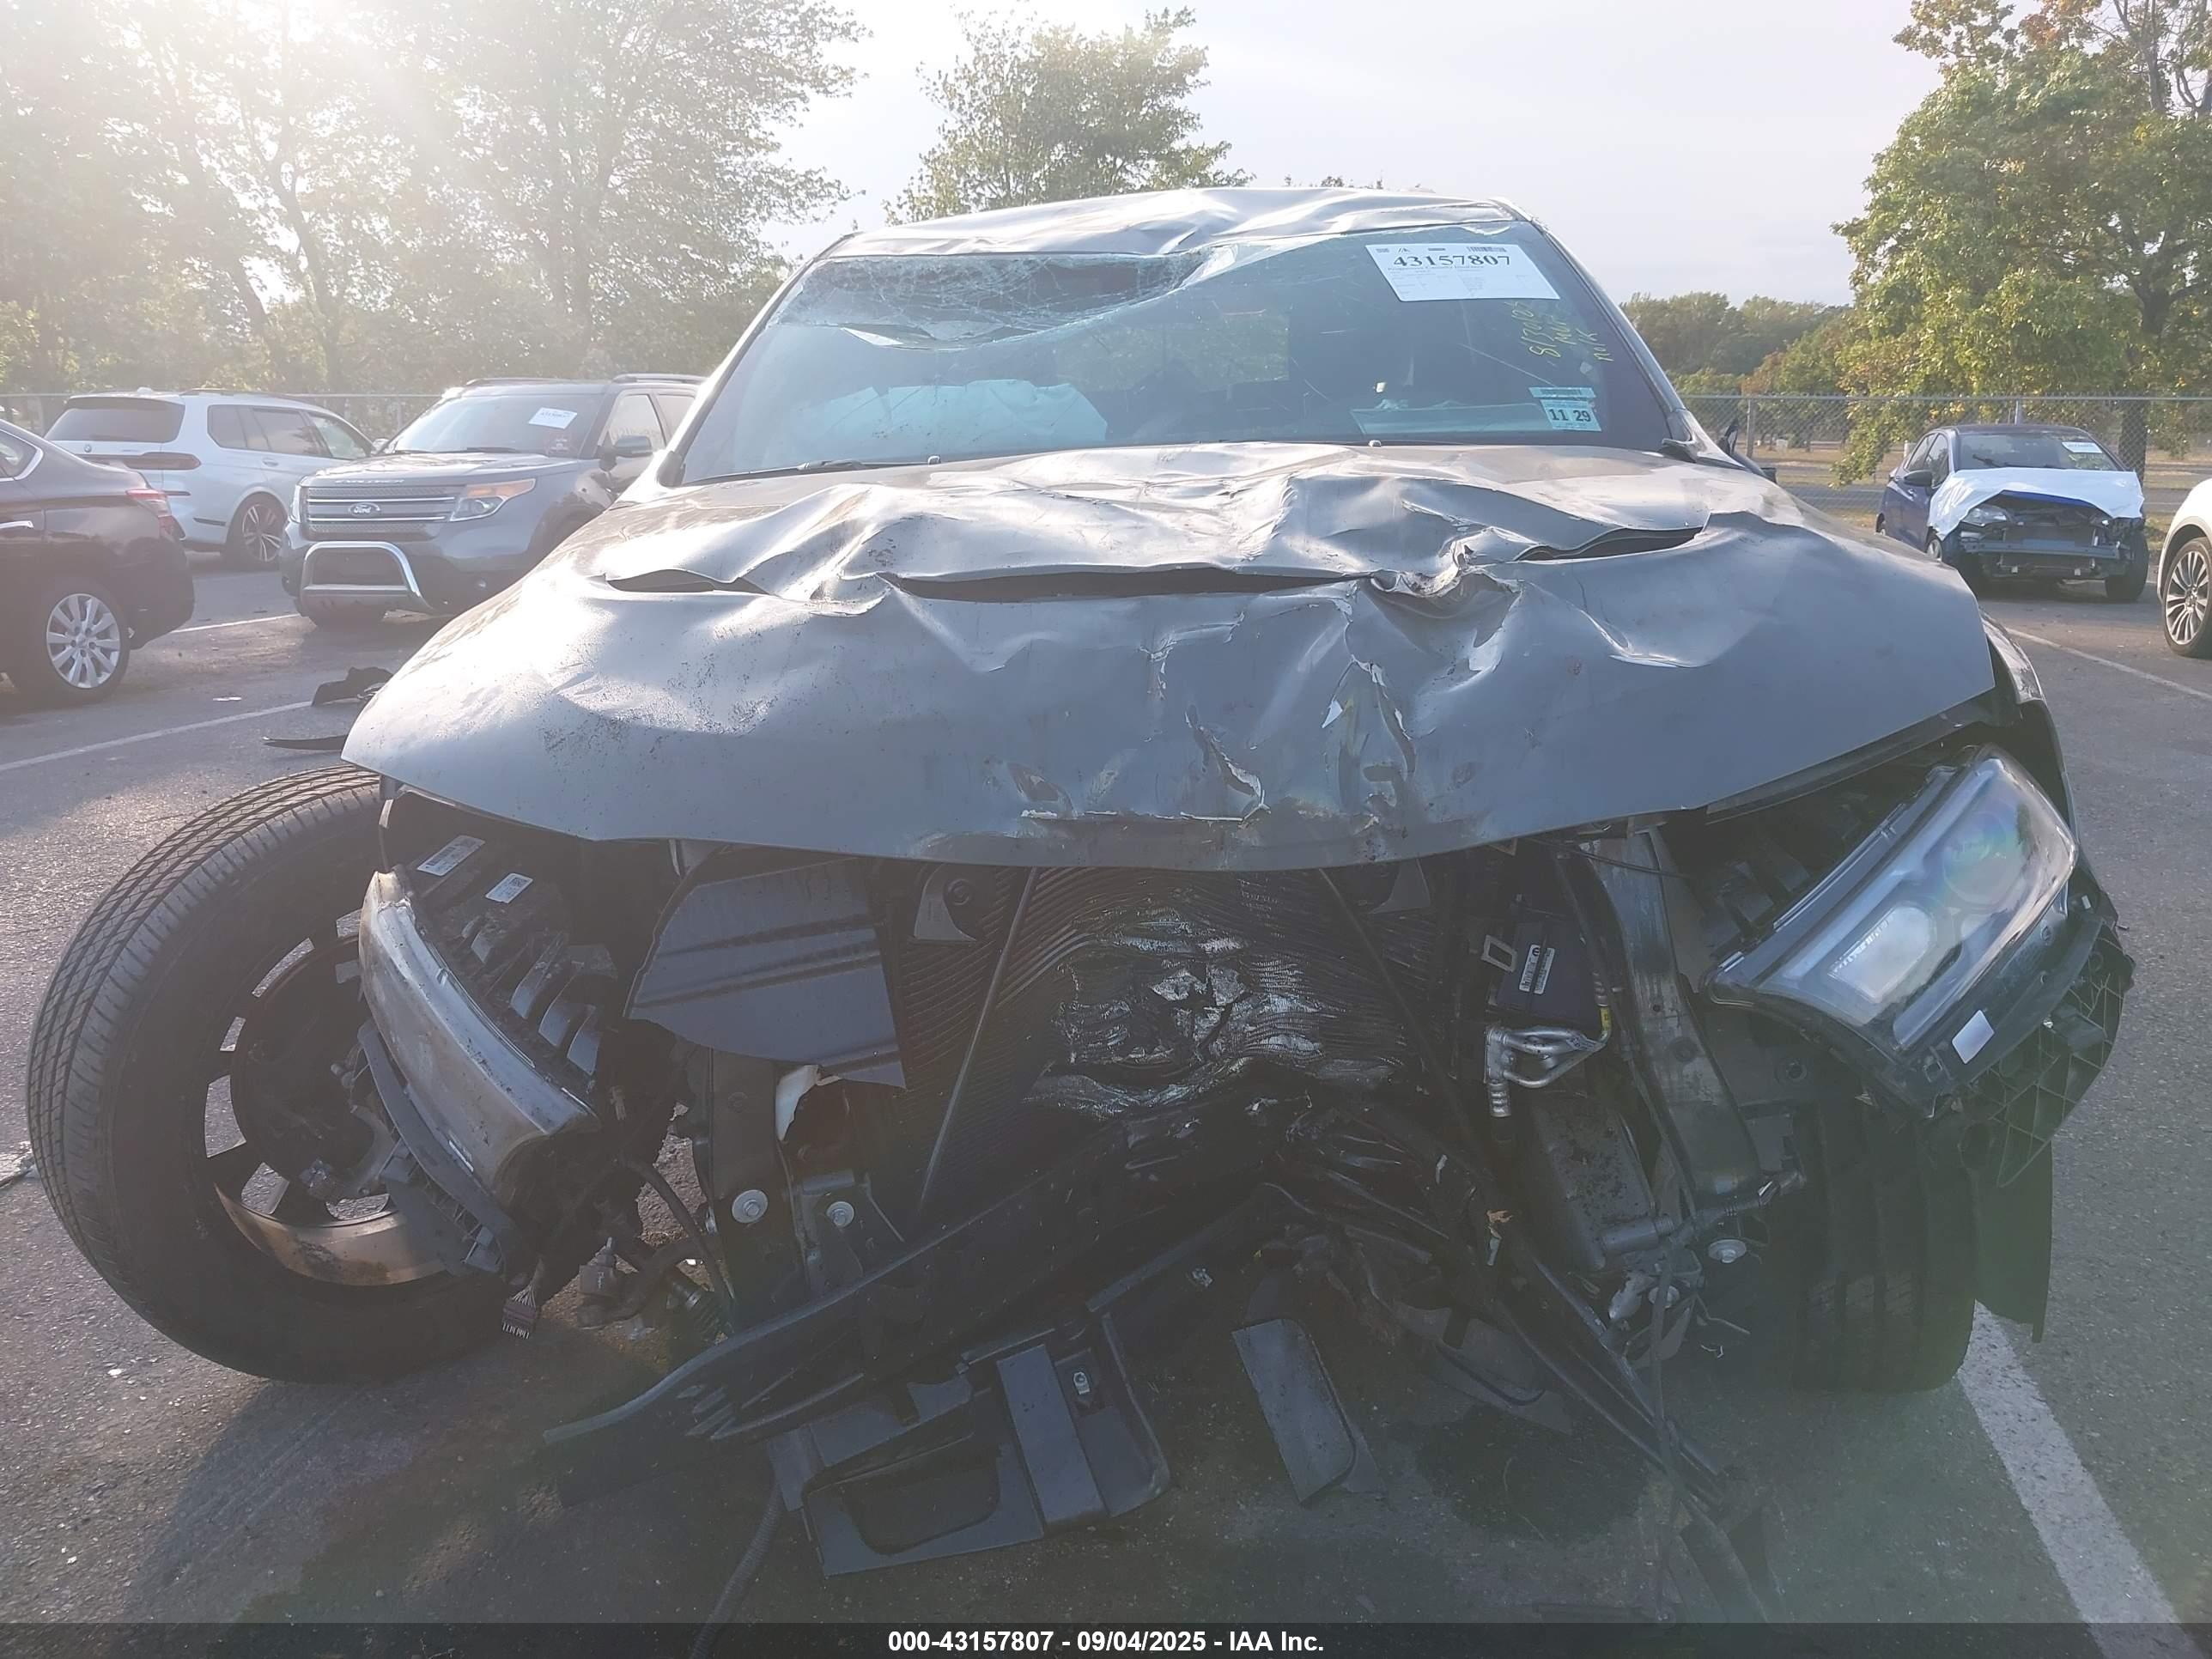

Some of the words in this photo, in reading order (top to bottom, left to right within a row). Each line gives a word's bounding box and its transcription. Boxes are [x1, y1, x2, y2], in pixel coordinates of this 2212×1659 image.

[1394, 255, 1510, 267] 43157807
[1548, 409, 1569, 421] 11
[1573, 410, 1592, 422] 29
